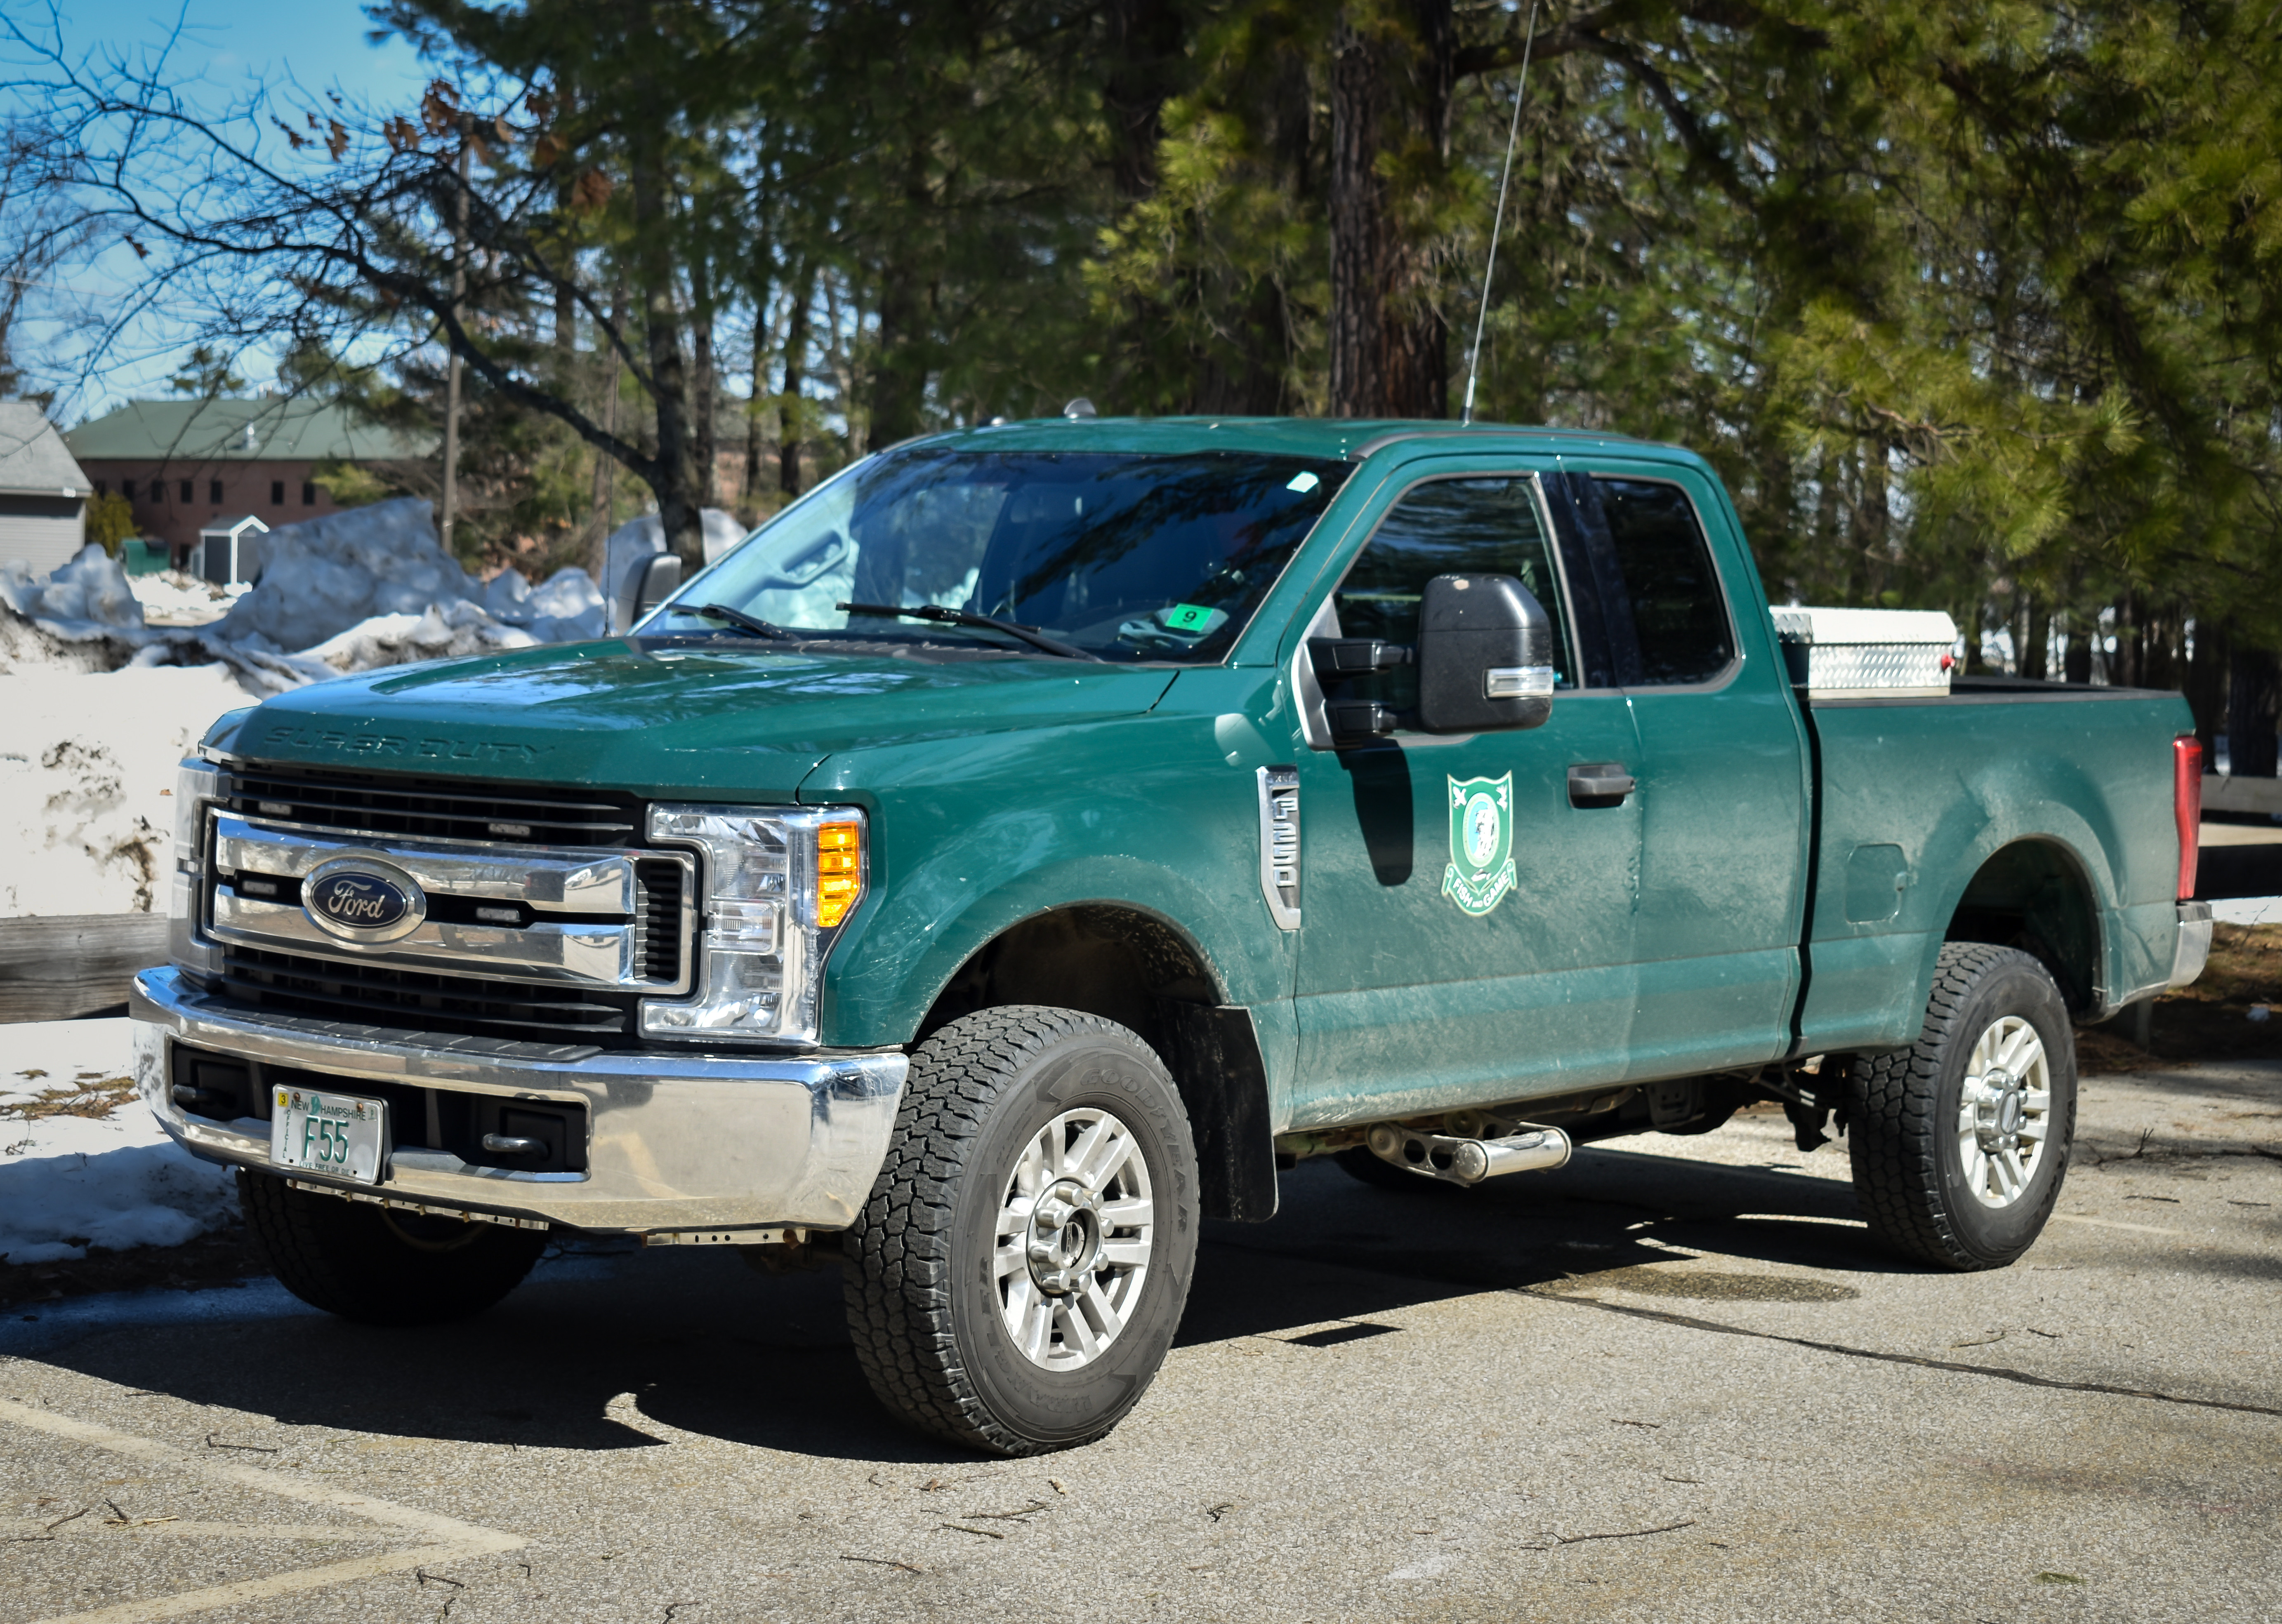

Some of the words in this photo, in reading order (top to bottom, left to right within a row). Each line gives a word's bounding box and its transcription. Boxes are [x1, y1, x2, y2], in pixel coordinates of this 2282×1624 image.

[1183, 610, 1196, 623] 9
[264, 726, 408, 756] SUPER
[413, 737, 556, 764] DUTY
[328, 880, 386, 918] Ford
[1452, 878, 1473, 907] FISH
[1483, 871, 1510, 907] GAME
[281, 1094, 286, 1104] 3
[291, 1099, 309, 1111] NEW
[321, 1104, 366, 1120] HAMPSHIRE
[304, 1115, 349, 1164] F55
[1080, 1069, 1188, 1234] GOODYEAR
[299, 1160, 312, 1169] LIVE
[314, 1163, 330, 1172] FREE
